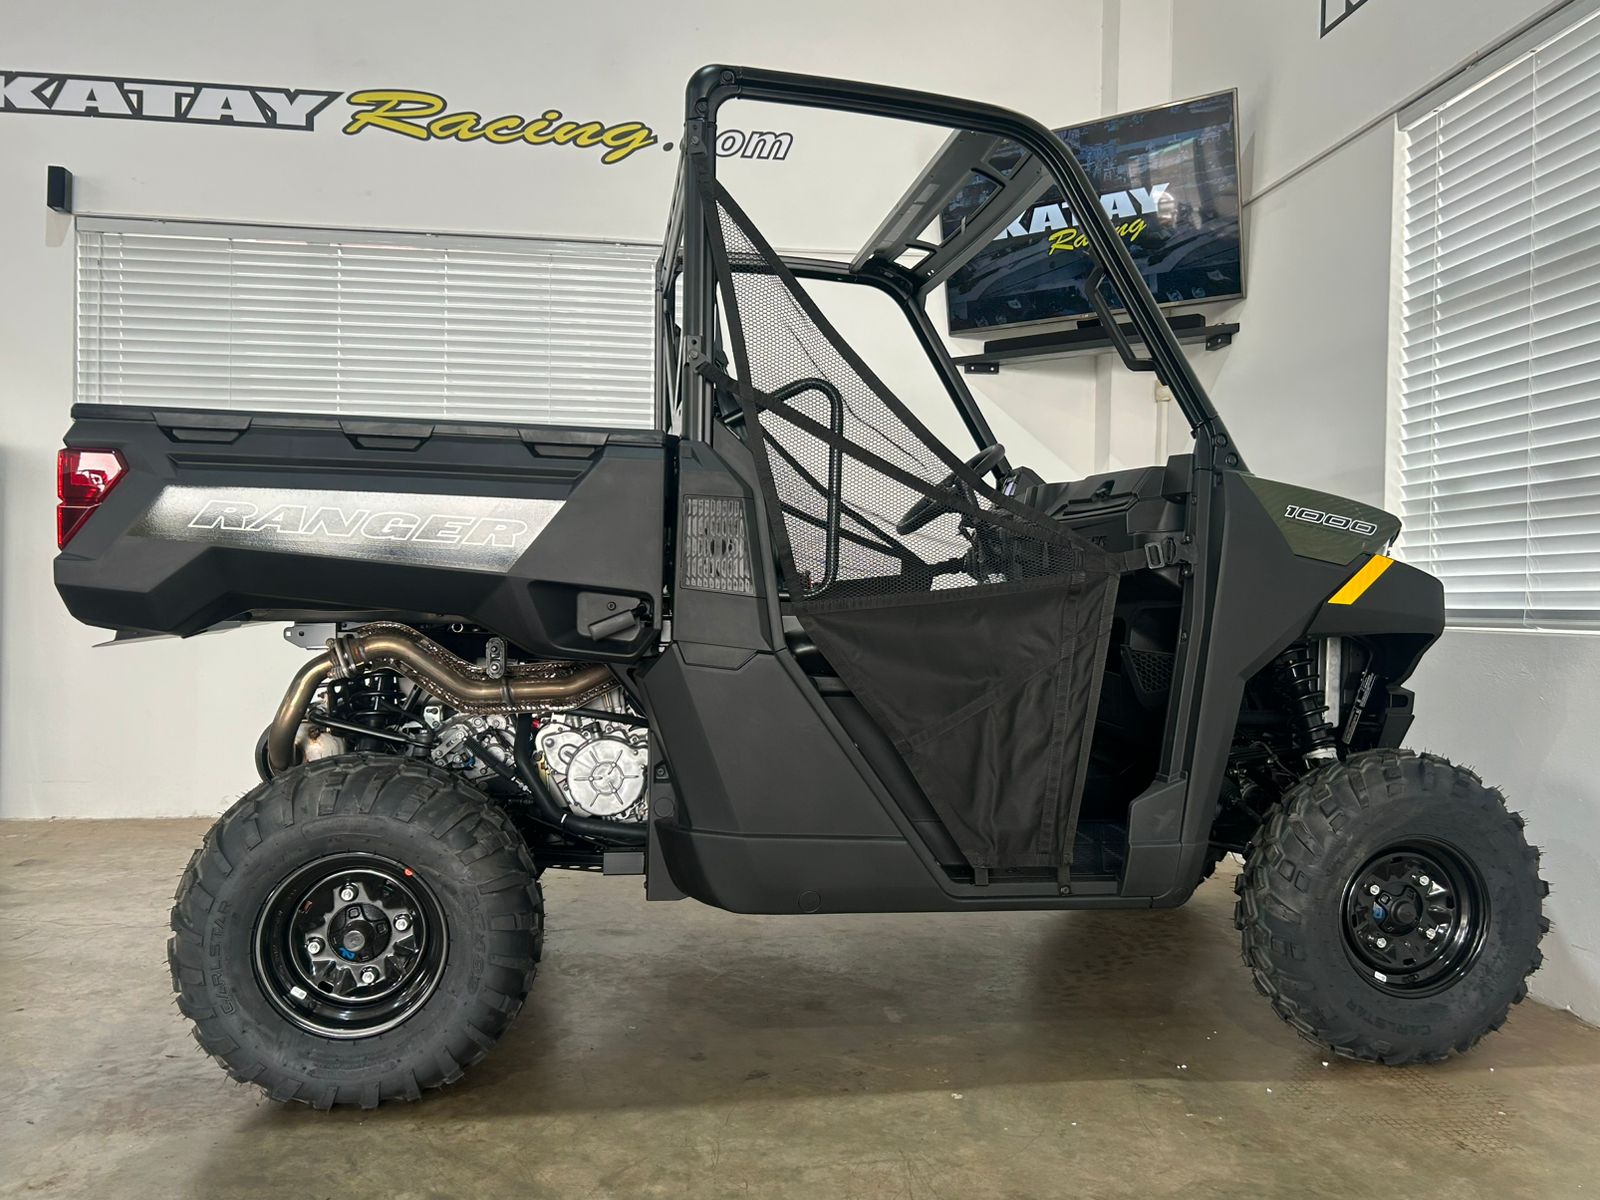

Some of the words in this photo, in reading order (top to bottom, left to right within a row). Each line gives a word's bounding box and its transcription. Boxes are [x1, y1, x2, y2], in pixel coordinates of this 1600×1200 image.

[0, 71, 344, 131] KATAY
[1048, 218, 1147, 255] Rang
[188, 500, 527, 547] RANGER
[1284, 504, 1378, 536] 1000
